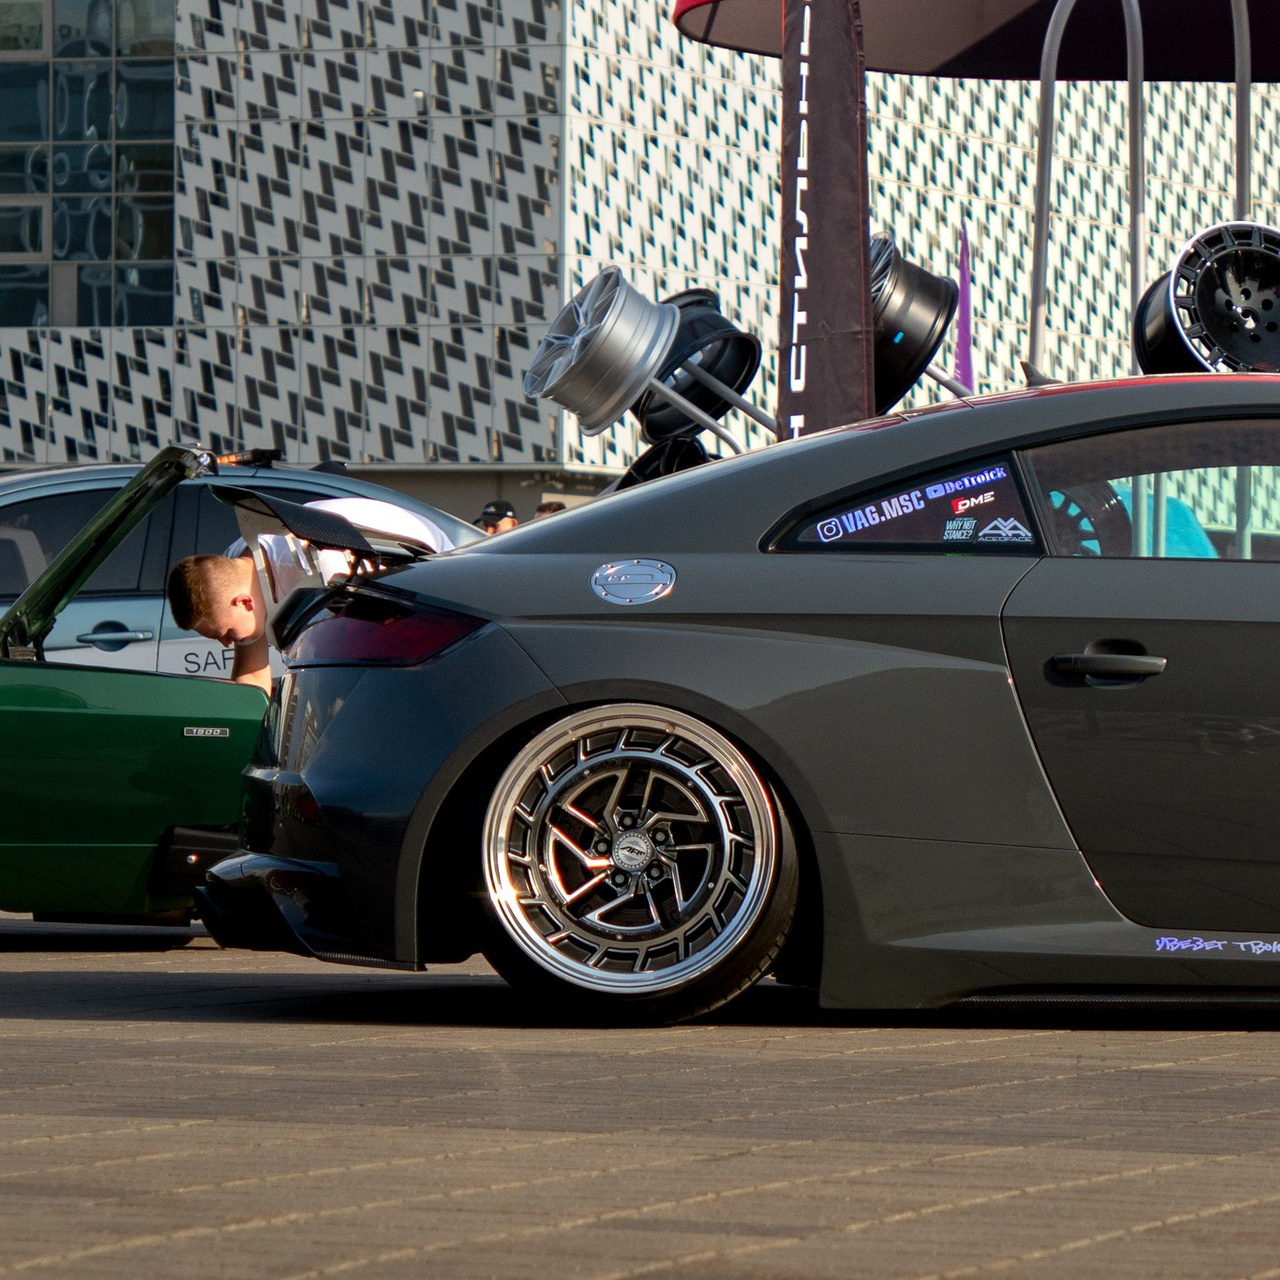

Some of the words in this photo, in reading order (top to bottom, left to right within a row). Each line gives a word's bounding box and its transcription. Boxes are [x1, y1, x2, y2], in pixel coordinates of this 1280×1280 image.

[841, 490, 926, 534] VAG.MSC
[946, 520, 963, 530] WHY
[184, 648, 235, 674] SAF
